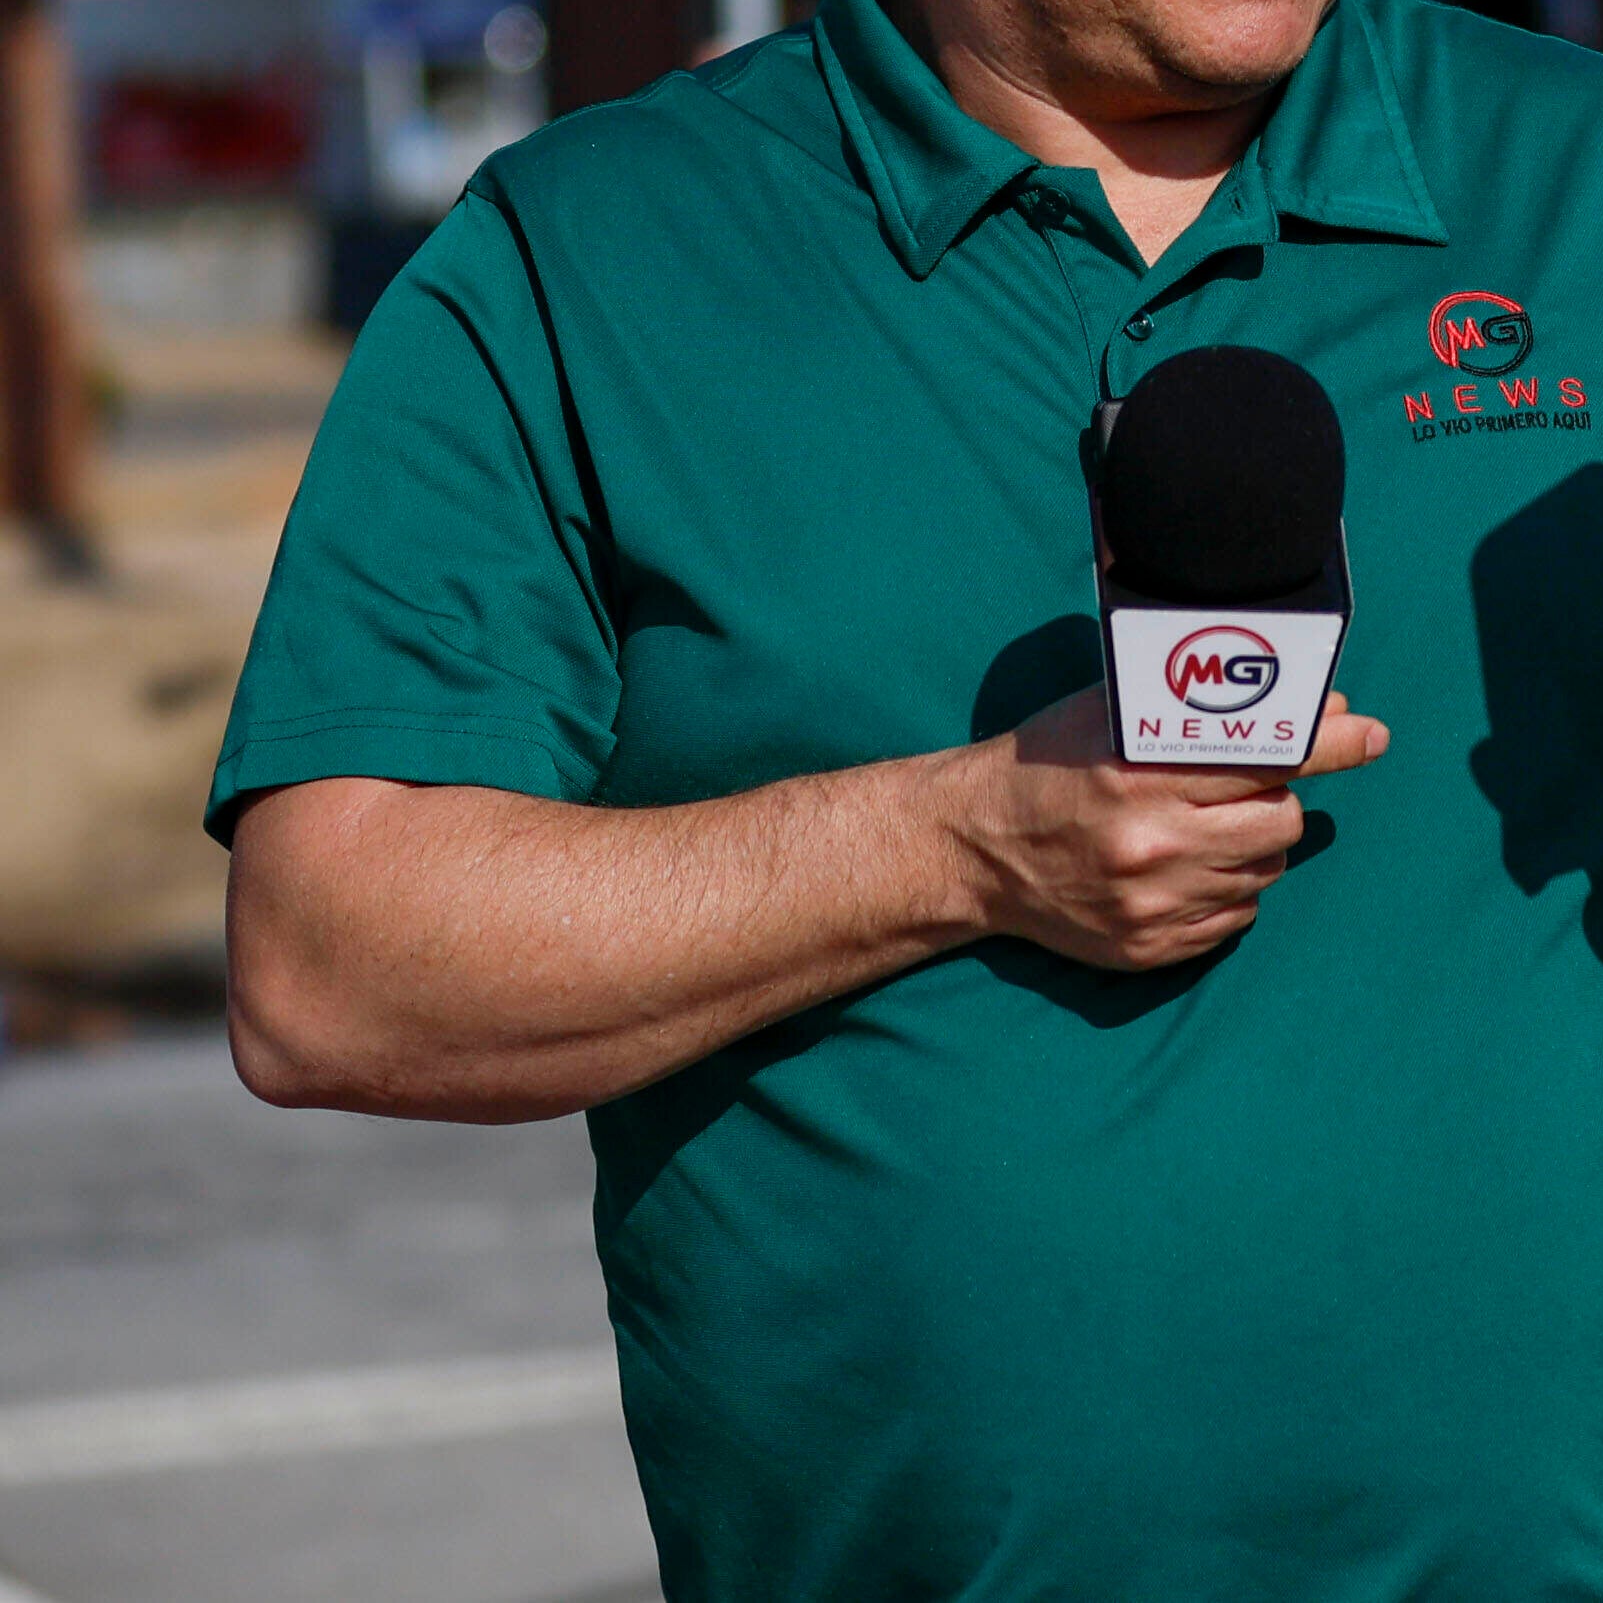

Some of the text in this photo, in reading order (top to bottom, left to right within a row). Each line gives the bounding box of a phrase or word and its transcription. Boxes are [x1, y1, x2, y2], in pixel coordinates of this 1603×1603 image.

[1403, 377, 1588, 423] NEWS
[1412, 424, 1437, 443] LO
[1475, 411, 1549, 432] PRIMERO
[1553, 410, 1592, 431] AQUI
[1138, 717, 1295, 741] NEWS
[1137, 743, 1154, 753] LO
[1189, 743, 1255, 755] PRIMERO
[1258, 744, 1294, 756] AQUI
